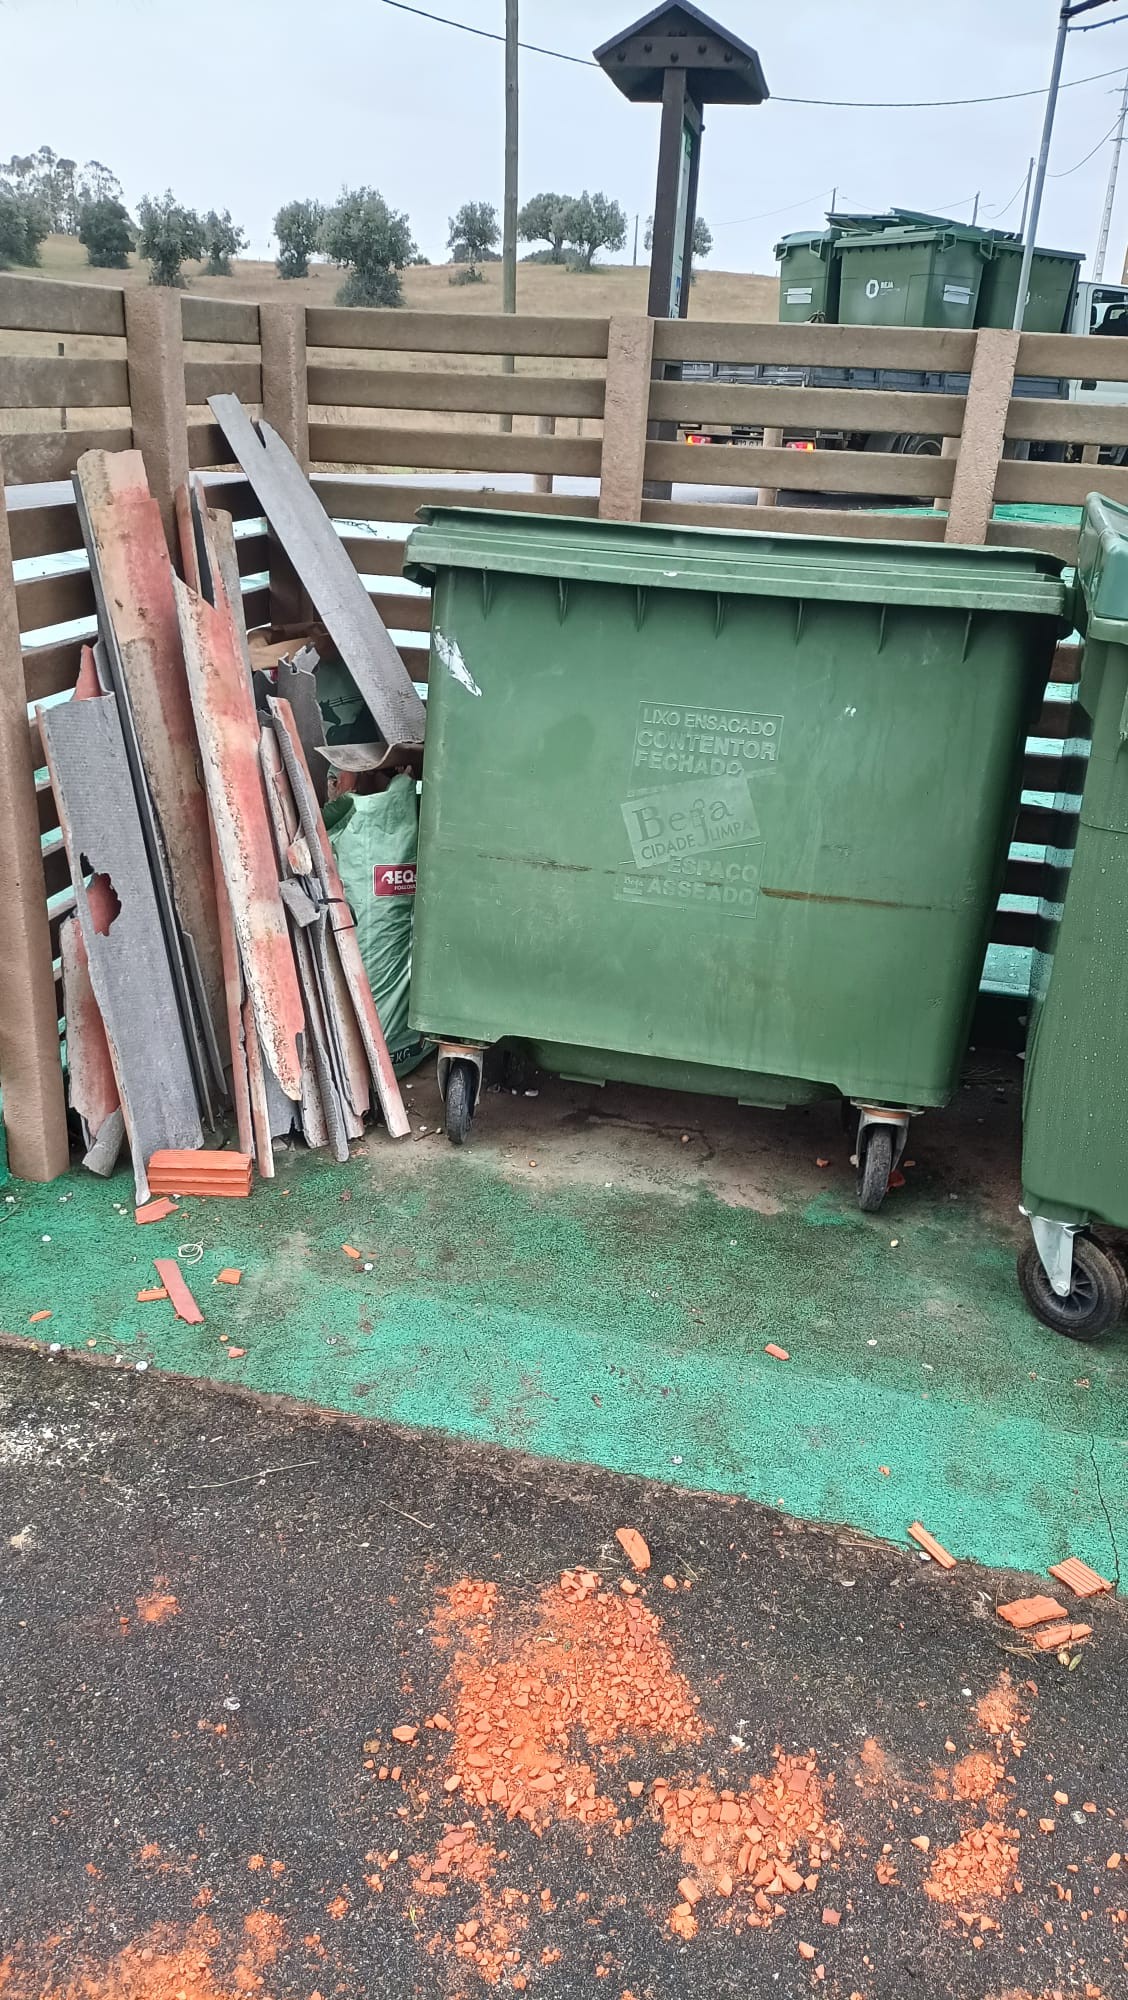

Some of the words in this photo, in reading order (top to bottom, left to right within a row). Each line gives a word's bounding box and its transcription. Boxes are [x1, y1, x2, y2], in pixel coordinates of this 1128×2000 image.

[643, 708, 681, 726] LIXO
[684, 713, 776, 736] ENSACADO
[637, 730, 777, 761] CONTENTOR
[634, 749, 744, 776] FECHADO
[641, 834, 696, 860] CIDADE
[709, 822, 755, 842] LIMPA
[667, 855, 758, 882] ESPAÇO
[648, 878, 756, 905] ASSEADO
